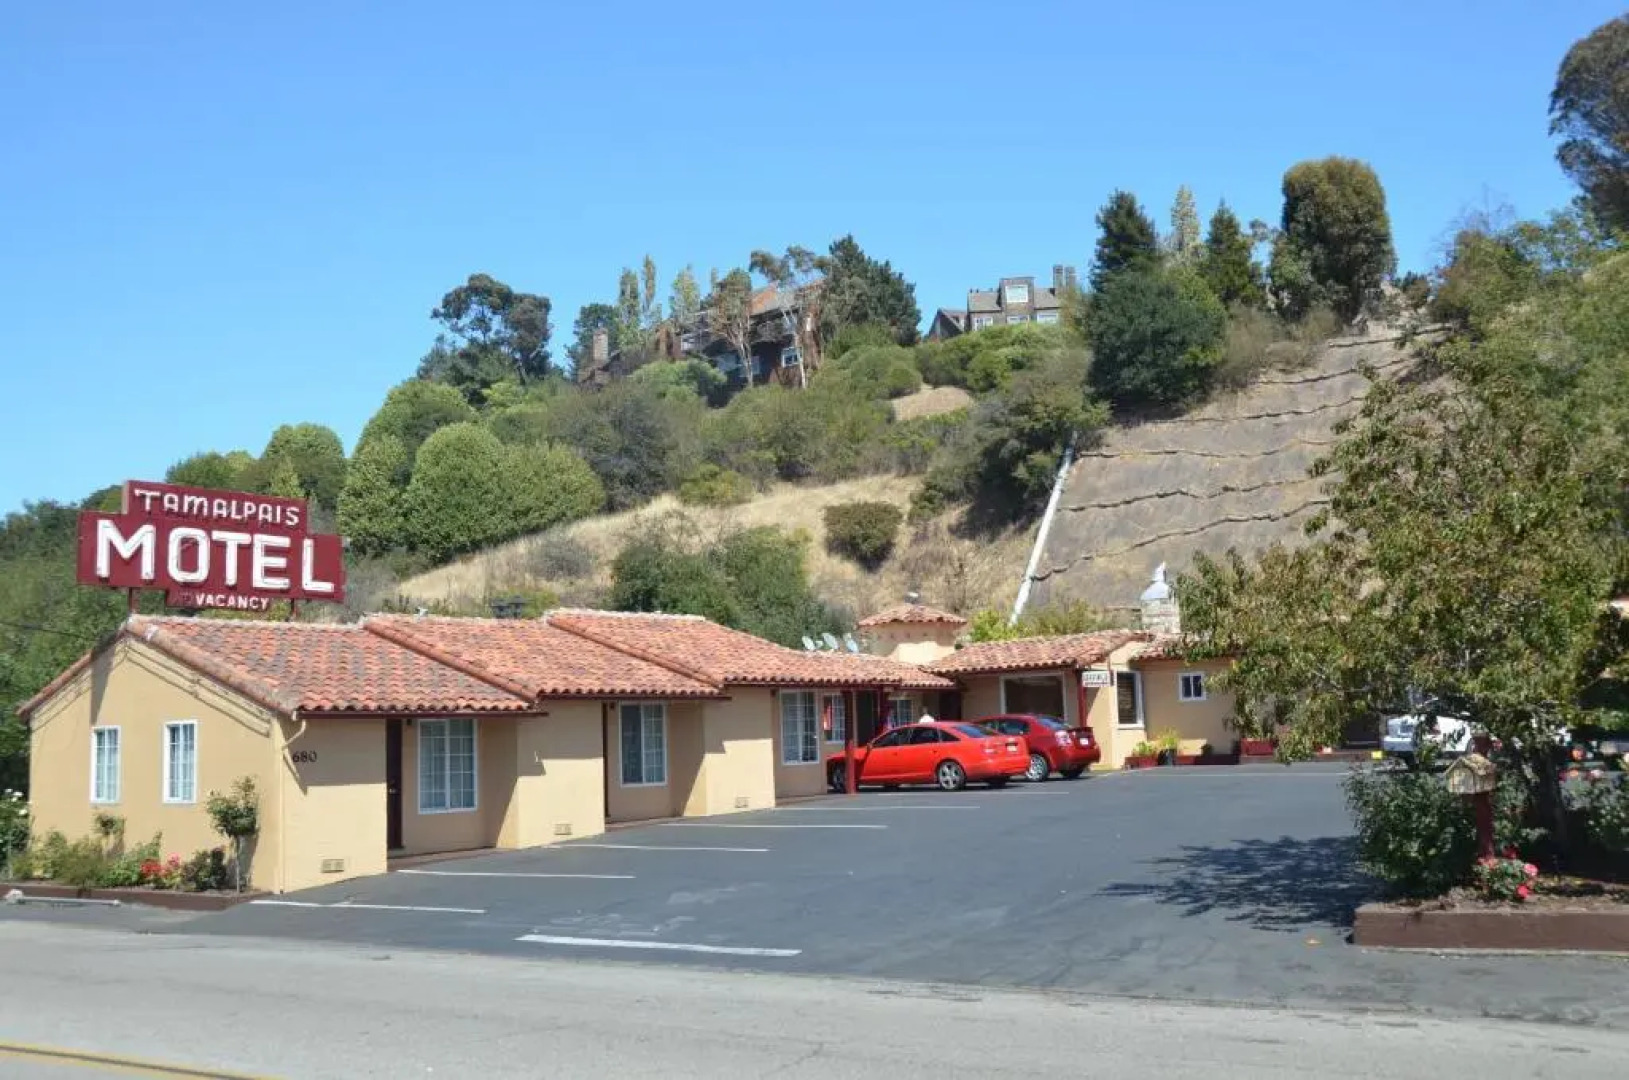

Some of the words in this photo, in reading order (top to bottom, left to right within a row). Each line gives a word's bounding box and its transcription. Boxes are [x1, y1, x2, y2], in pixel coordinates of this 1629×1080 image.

[134, 488, 300, 526] TAMALPAIS
[96, 519, 334, 593] MOTEL
[195, 592, 270, 610] VACANCY
[292, 750, 317, 763] 680
